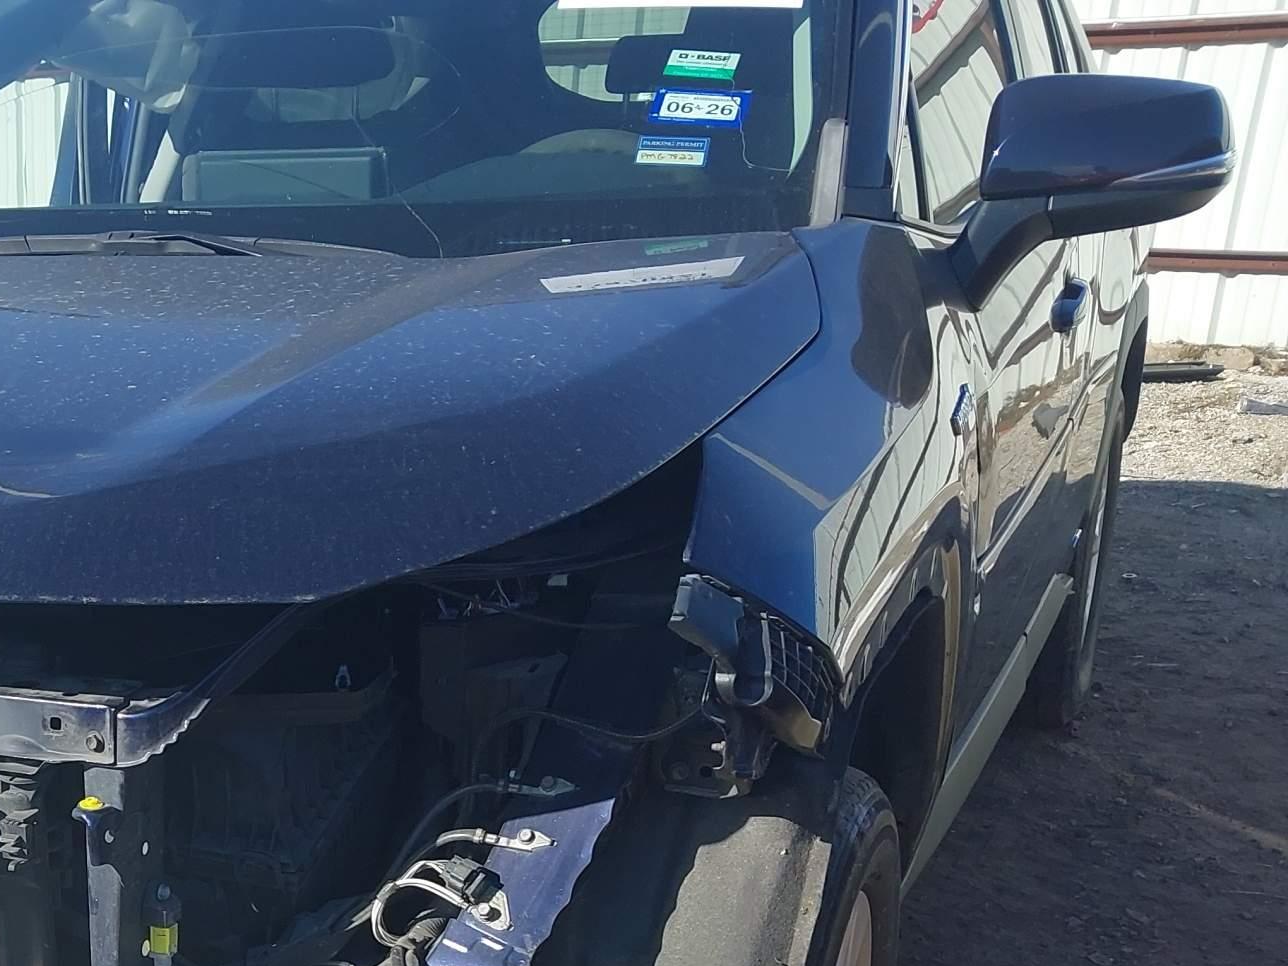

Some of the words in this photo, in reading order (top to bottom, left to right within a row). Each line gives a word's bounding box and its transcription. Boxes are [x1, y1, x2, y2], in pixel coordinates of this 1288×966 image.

[696, 53, 731, 62] BASF
[667, 101, 694, 114] 06
[705, 103, 734, 116] 26
